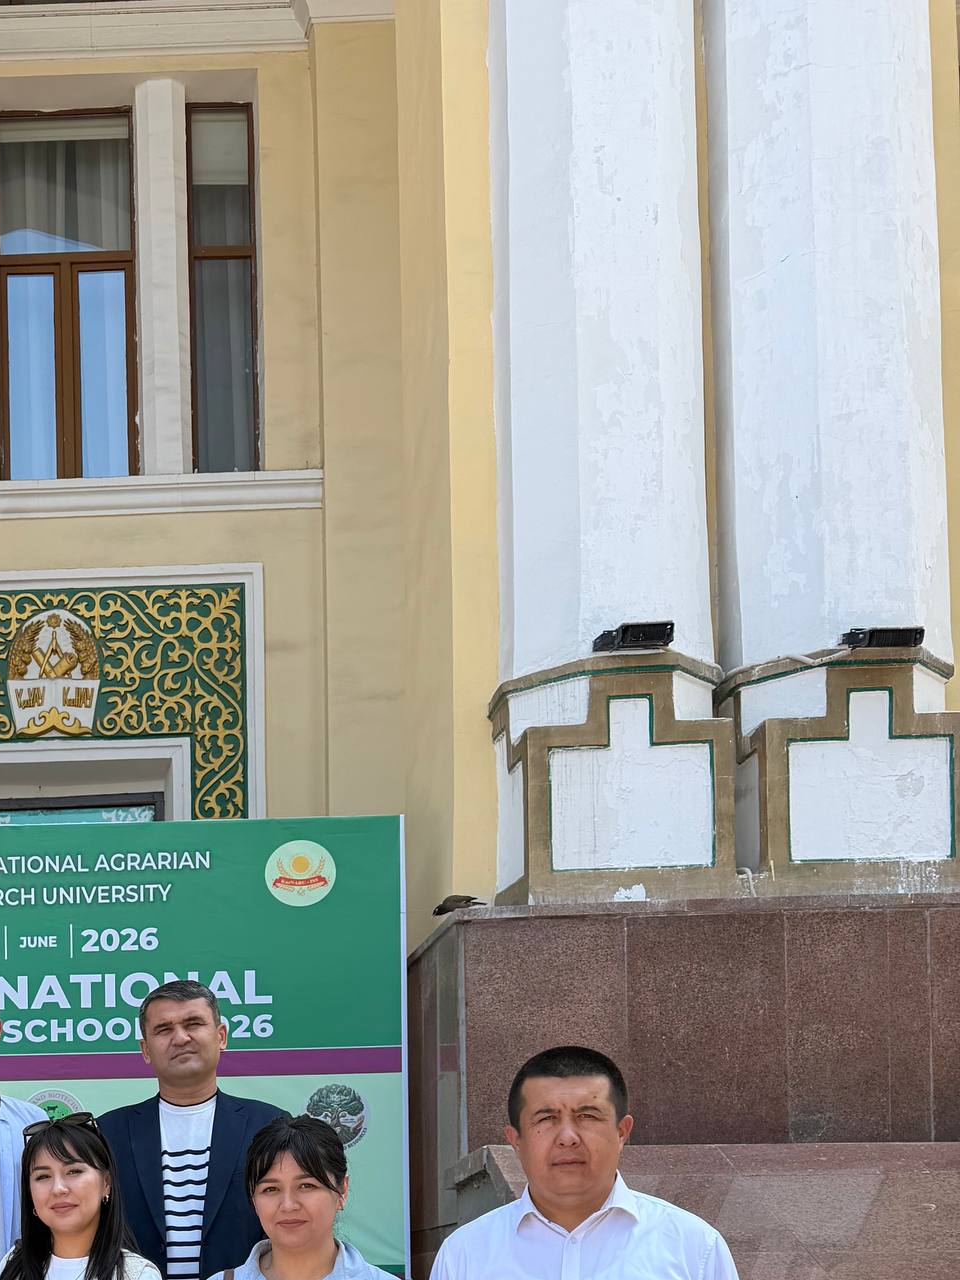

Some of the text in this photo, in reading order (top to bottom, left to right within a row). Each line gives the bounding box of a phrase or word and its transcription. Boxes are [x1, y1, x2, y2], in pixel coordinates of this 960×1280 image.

[94, 851, 211, 872] AGRARIAN
[43, 884, 172, 905] UNIVERSITY
[19, 935, 58, 949] JUNE
[80, 927, 160, 953] 2026
[227, 1013, 274, 1039] 26
